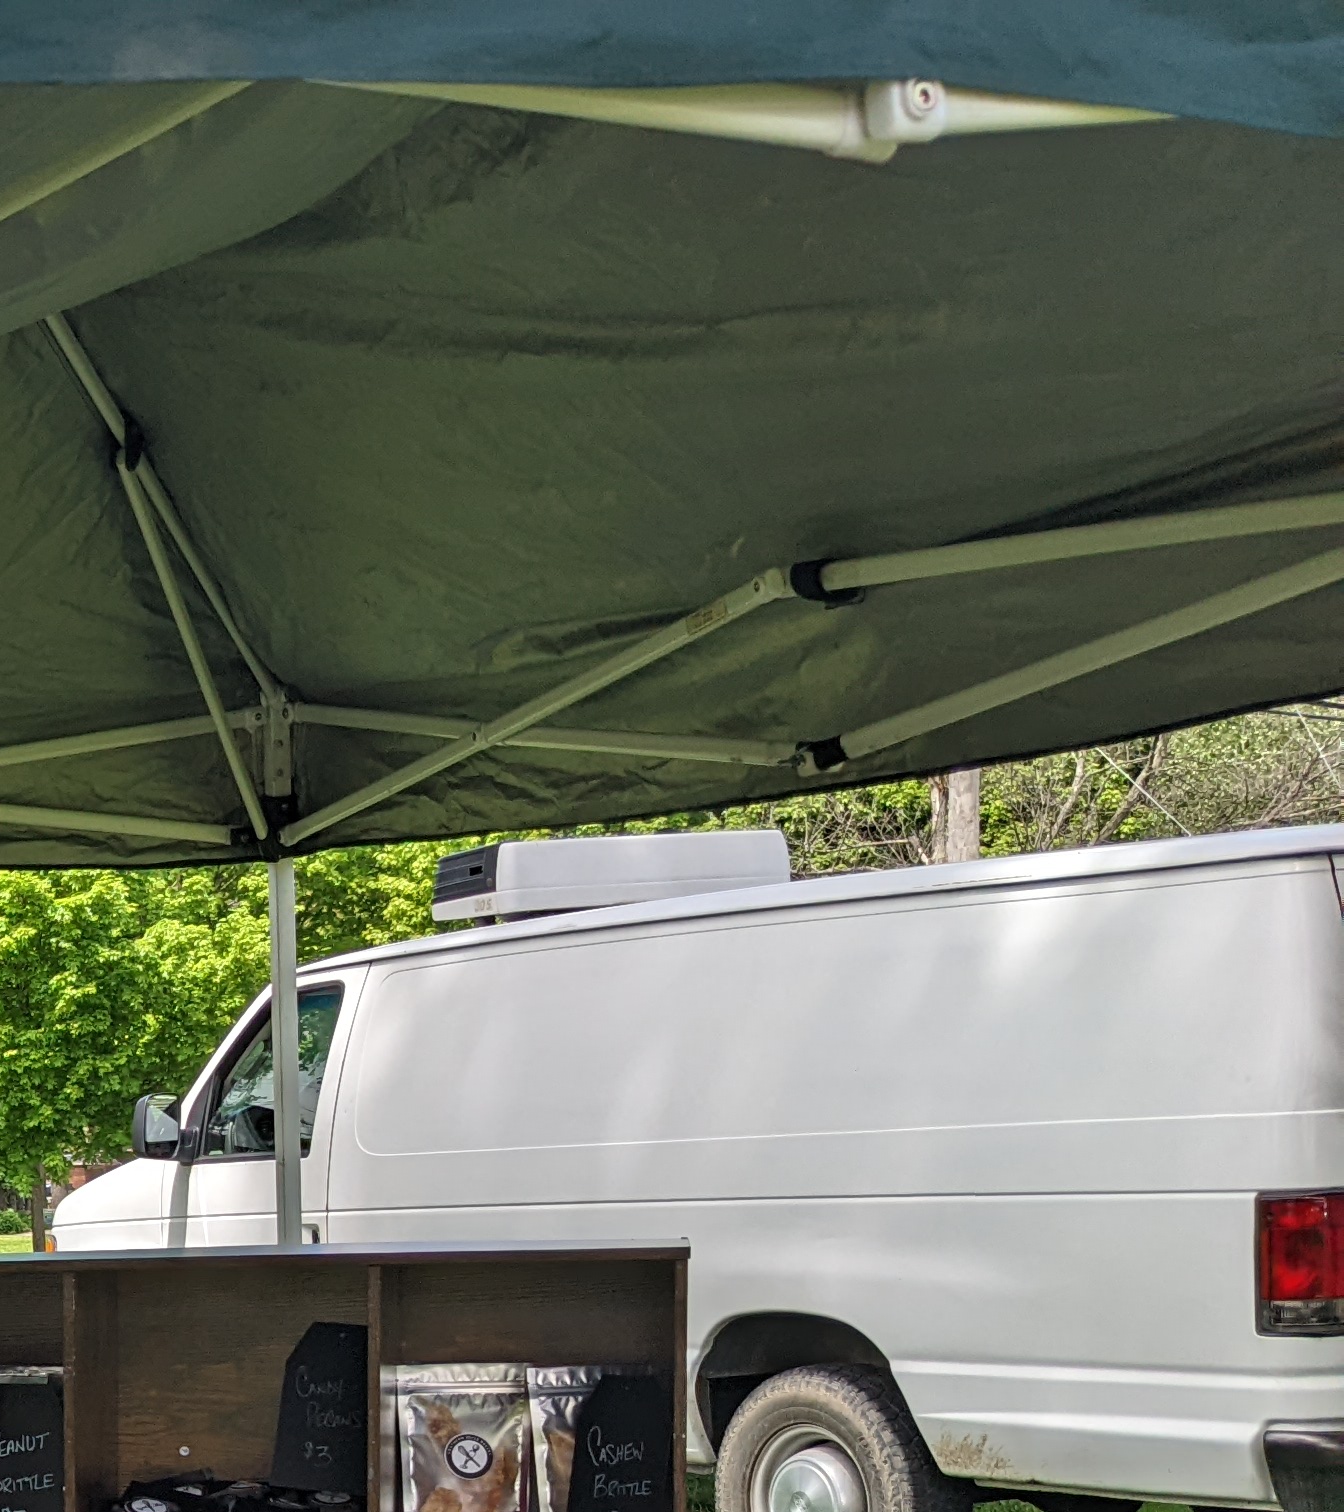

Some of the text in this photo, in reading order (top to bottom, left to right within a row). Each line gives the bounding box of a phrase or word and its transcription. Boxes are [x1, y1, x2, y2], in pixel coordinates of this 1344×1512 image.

[304, 1441, 332, 1468] $3
[587, 1425, 644, 1467] CASHEW
[593, 1473, 652, 1499] BRITTLE
